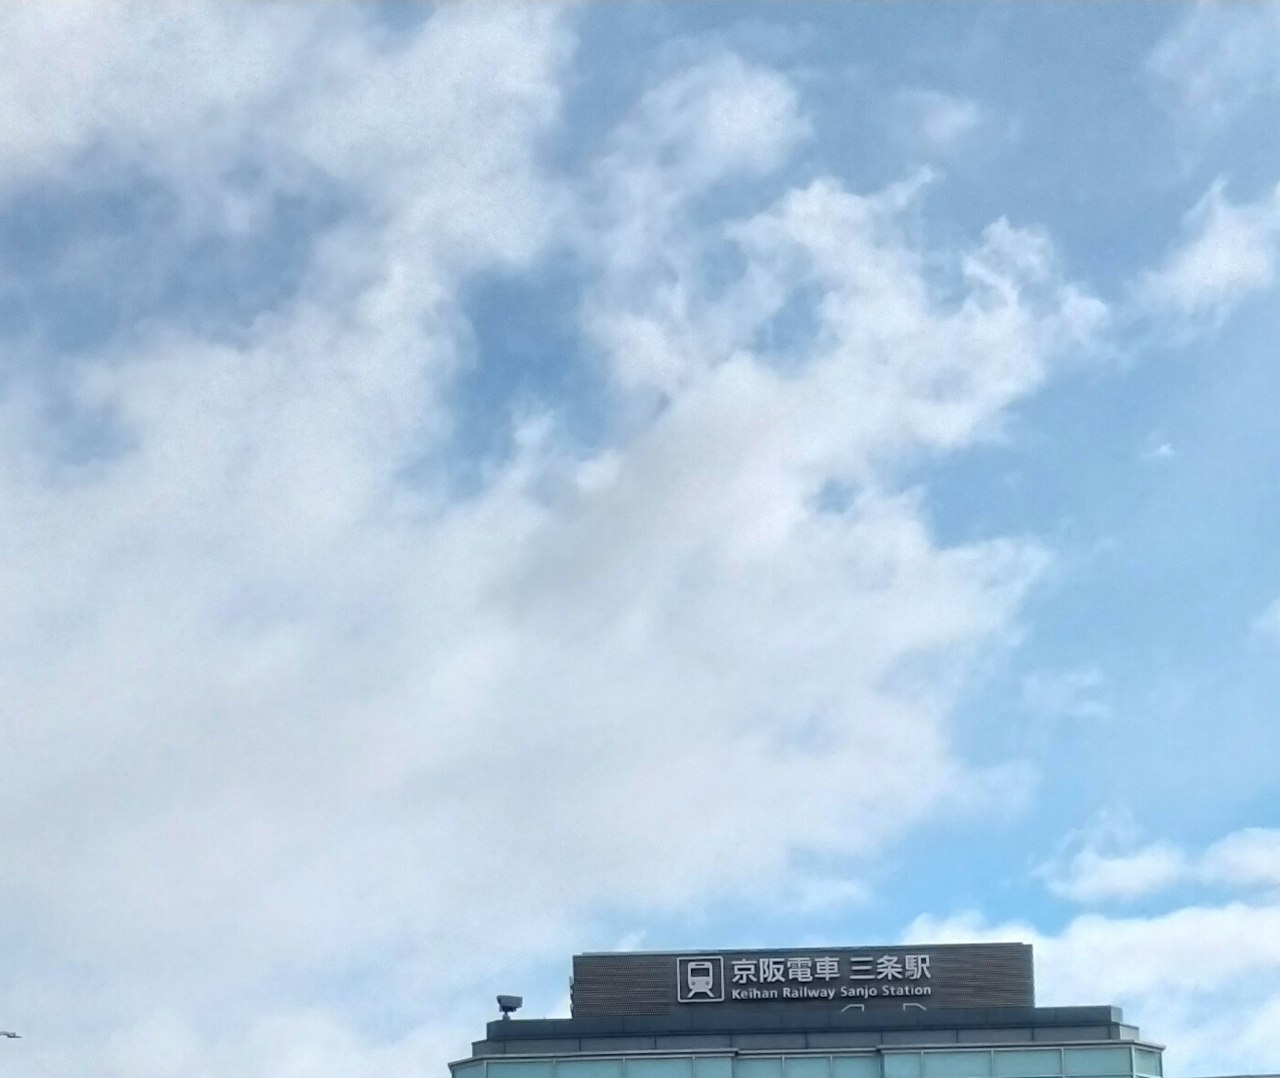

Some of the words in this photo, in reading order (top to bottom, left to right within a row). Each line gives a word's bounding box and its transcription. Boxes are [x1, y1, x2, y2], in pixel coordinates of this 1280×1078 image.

[731, 958, 840, 984] 京阪電車
[849, 954, 931, 980] 三条駅
[732, 988, 778, 999] Keihan
[783, 985, 835, 999] Railway
[840, 984, 878, 998] Sanjo
[882, 984, 932, 996] Station
